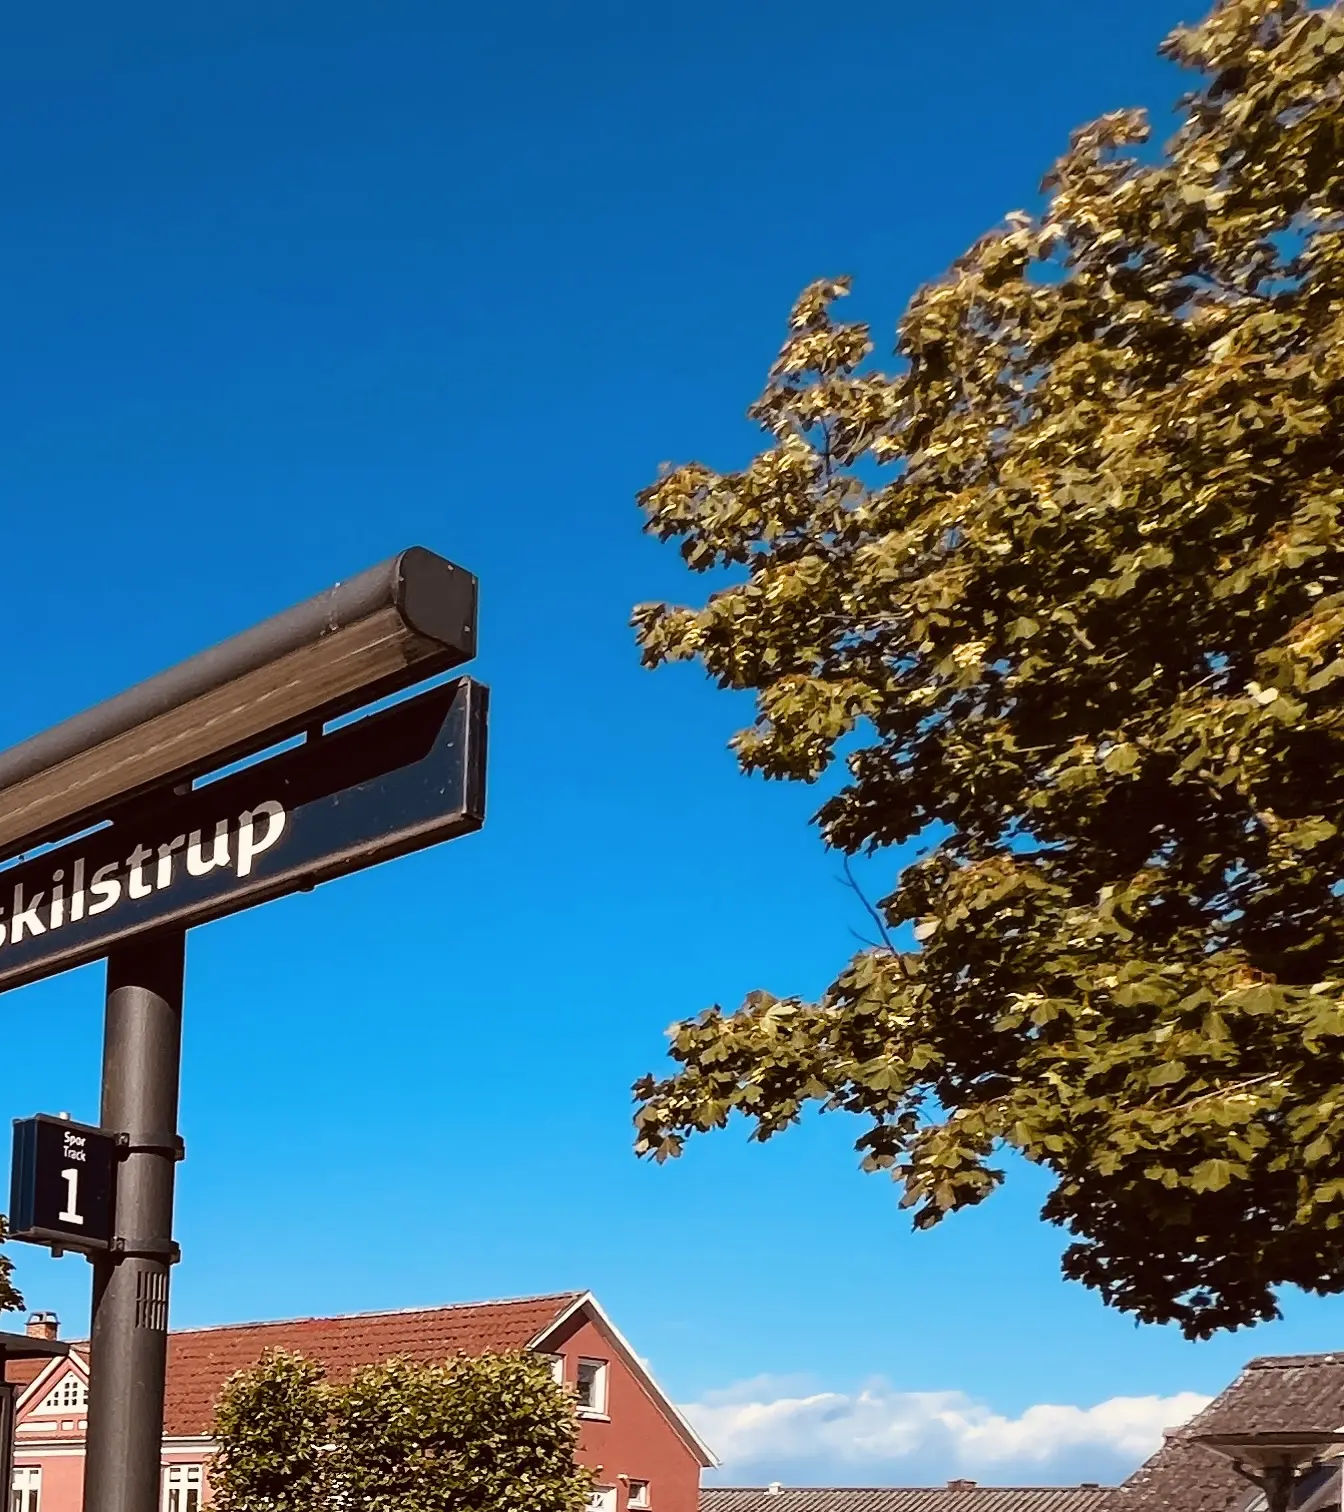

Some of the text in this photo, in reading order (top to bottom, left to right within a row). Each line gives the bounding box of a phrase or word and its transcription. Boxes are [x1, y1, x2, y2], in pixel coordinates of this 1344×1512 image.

[64, 1131, 86, 1147] Spor
[63, 1145, 87, 1162] Track
[58, 1168, 84, 1225] 1
